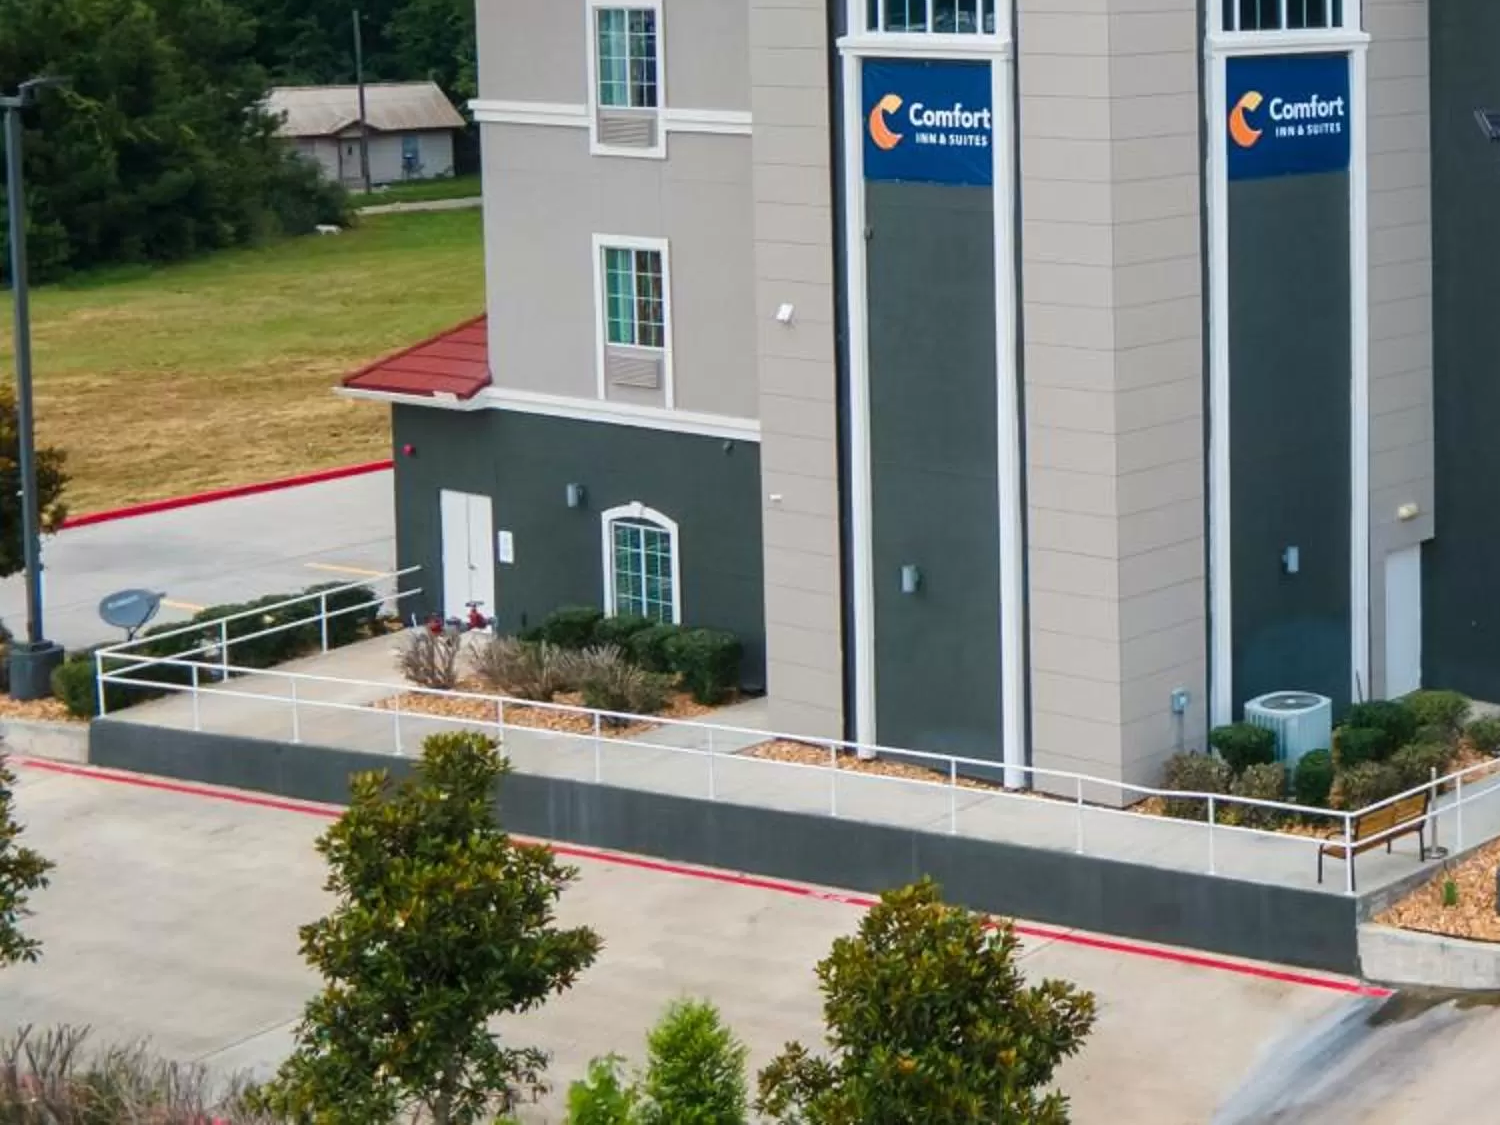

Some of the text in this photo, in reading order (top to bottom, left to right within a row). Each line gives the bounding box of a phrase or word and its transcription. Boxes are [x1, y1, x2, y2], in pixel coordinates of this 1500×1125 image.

[908, 102, 992, 130] Comfort
[1269, 93, 1345, 121] Comfort
[915, 131, 937, 146] INN
[949, 133, 989, 148] SUITES
[1275, 125, 1295, 139] INN
[1306, 121, 1342, 137] SUITES
